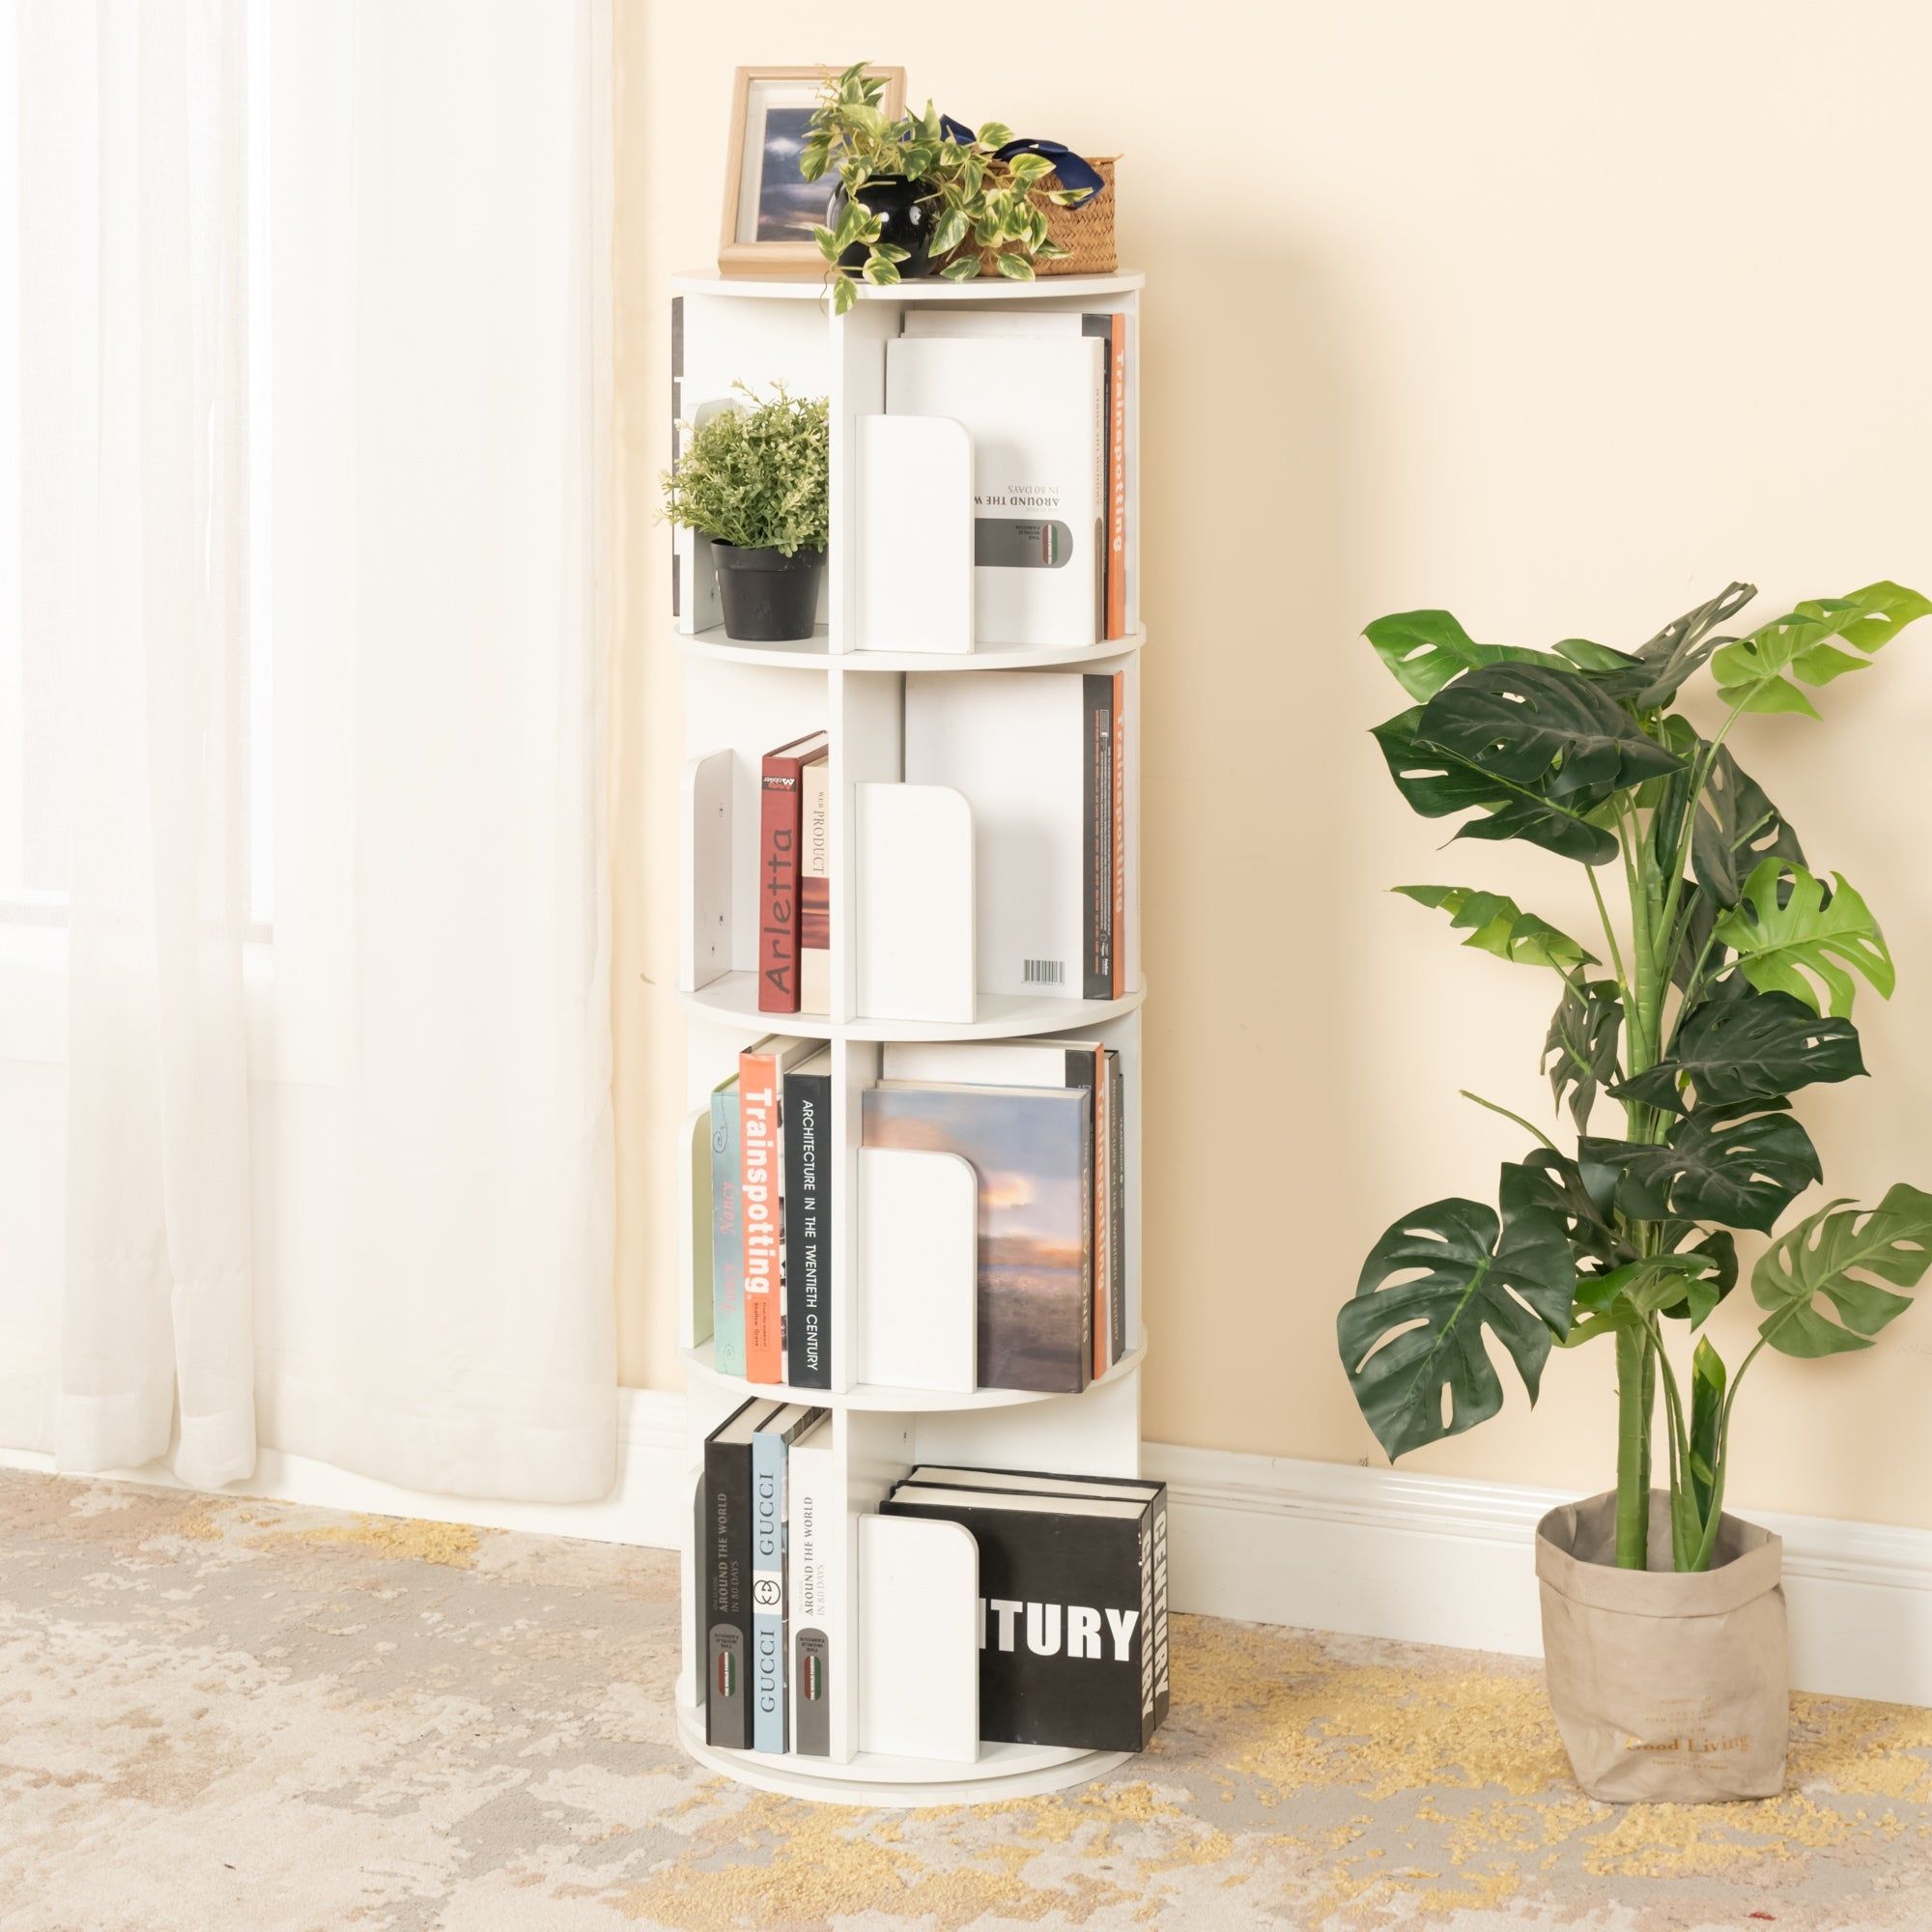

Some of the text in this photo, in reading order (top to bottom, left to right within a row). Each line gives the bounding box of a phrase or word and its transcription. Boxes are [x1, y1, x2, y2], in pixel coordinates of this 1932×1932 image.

[1008, 485, 1033, 494] DAYS
[1113, 349, 1124, 553] Trainspotting
[985, 496, 1007, 505] THE
[1009, 496, 1060, 506] AROUND
[812, 810, 825, 874] PRODUCT
[763, 829, 793, 995] Arletta
[742, 1088, 776, 1294] Trainspotting
[802, 1099, 819, 1372] ARCHITECTURE IN THE TWENTIETH CENTURY
[717, 1492, 728, 1613] AROUND THE WORLD
[759, 1471, 774, 1555] GUCCI
[729, 1560, 740, 1612] IN 80 DAYS
[803, 1496, 813, 1616] AROUND THE WORLD
[816, 1564, 825, 1616] IN 80 DAYS
[1141, 1529, 1154, 1720] CENTURY
[1153, 1509, 1169, 1700] CENTURY
[760, 1630, 775, 1713] GUCCI
[1688, 1735, 1750, 1753] Living
